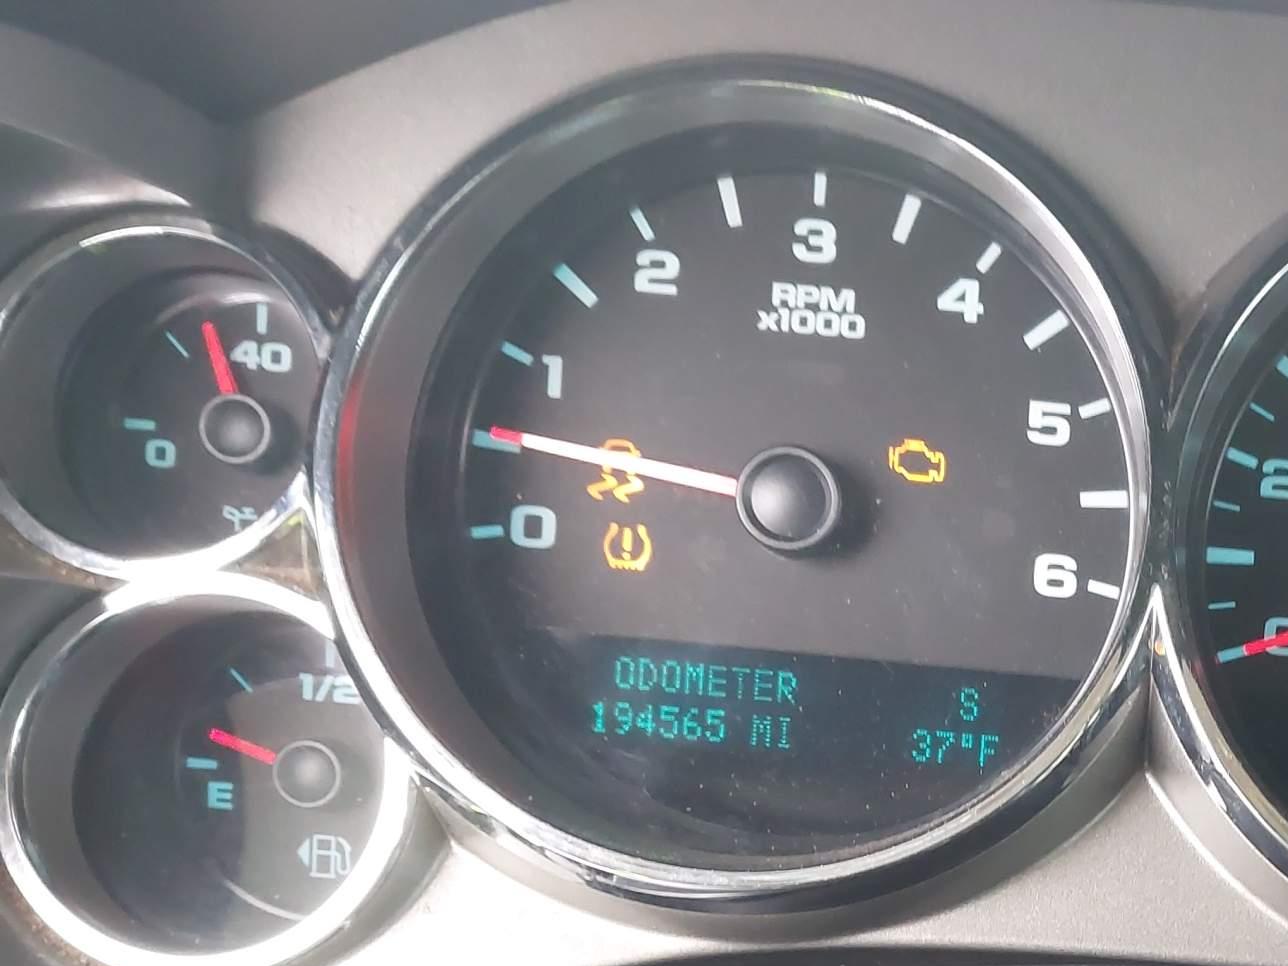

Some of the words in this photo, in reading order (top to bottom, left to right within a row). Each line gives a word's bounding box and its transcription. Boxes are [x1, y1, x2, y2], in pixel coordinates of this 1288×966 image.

[792, 218, 837, 263] 3
[634, 250, 680, 296] 2
[771, 281, 856, 314] RPM
[936, 278, 984, 324] 4
[756, 307, 866, 340] x1000
[231, 342, 292, 372] 40
[541, 354, 563, 399] 1
[1027, 399, 1072, 447] 5
[145, 440, 176, 469] 0
[509, 505, 556, 549] 0
[1033, 553, 1077, 599] 6
[299, 674, 362, 703] 1/2
[615, 655, 798, 704] ODOMETER
[590, 701, 726, 744] 194565
[750, 714, 792, 750] MI
[207, 782, 233, 809] E
